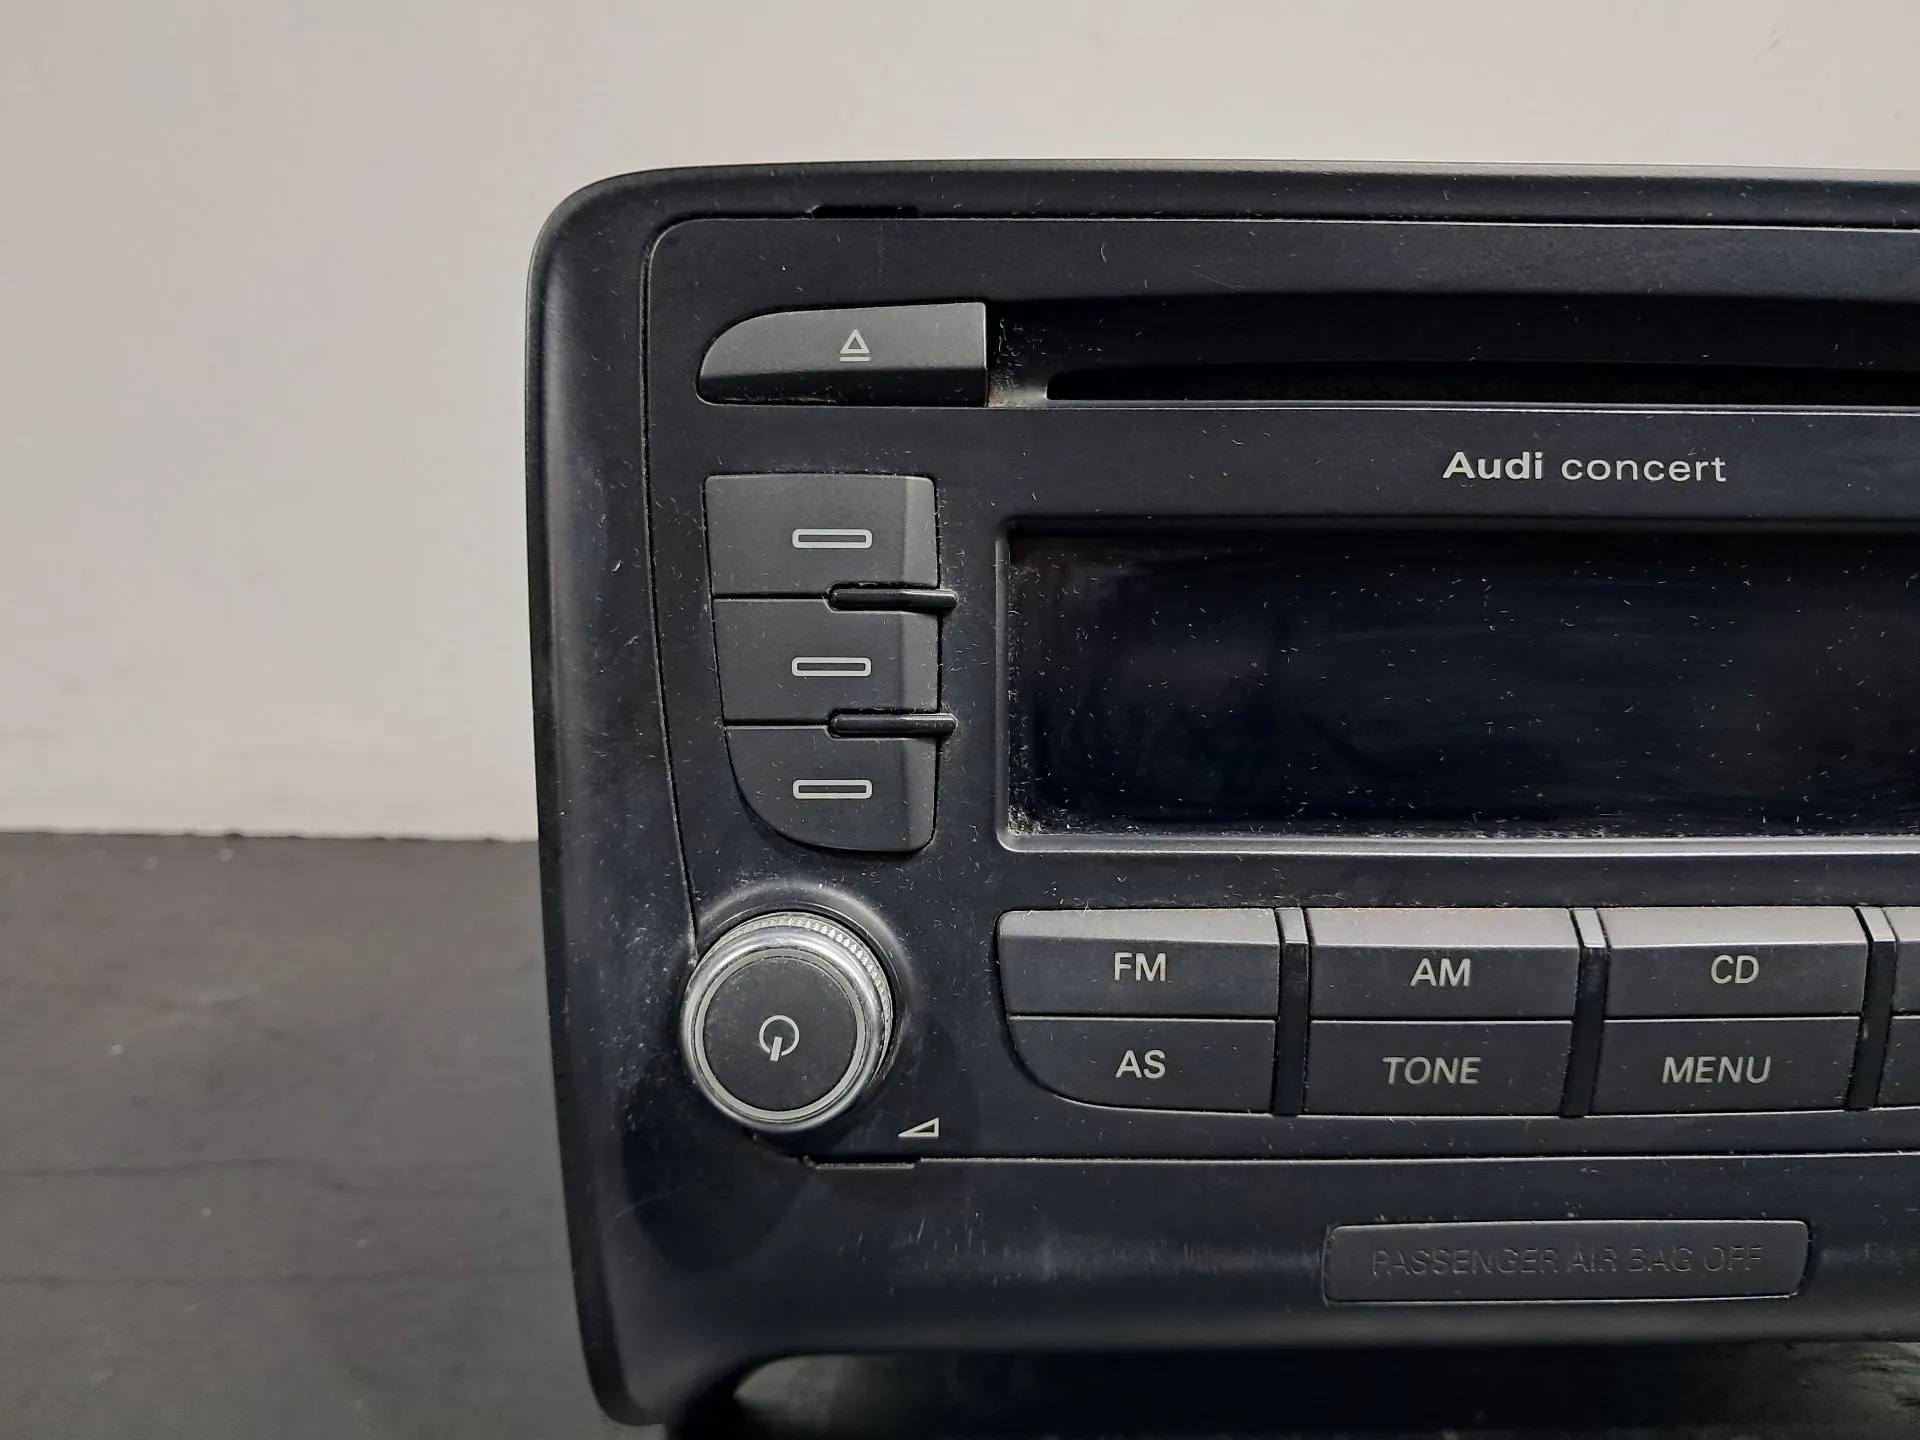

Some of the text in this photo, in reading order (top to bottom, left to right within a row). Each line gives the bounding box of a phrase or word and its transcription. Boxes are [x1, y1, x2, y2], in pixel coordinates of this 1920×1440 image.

[1442, 451, 1727, 482] Audi concert
[1114, 952, 1167, 982] FM
[1410, 957, 1471, 987] AM
[1710, 954, 1760, 985] CD
[1115, 1049, 1166, 1079] AS
[1382, 1056, 1481, 1085] TONE
[1662, 1056, 1771, 1084] MENU
[1371, 1244, 1765, 1276] PASSENGER AIR BAG OFF
